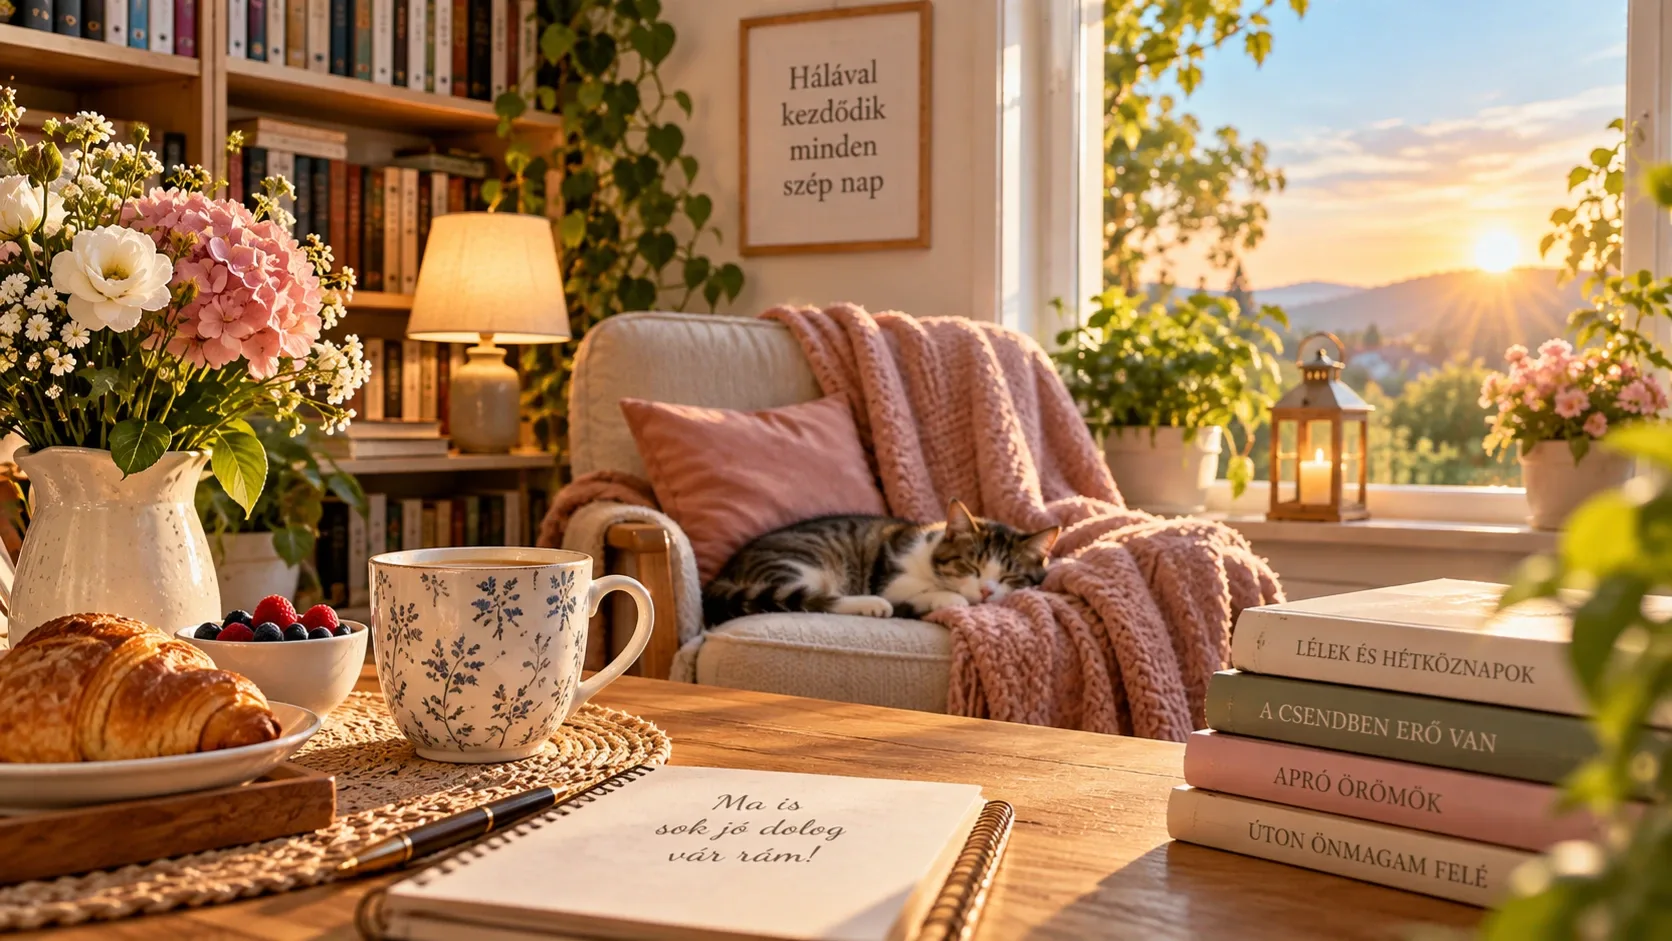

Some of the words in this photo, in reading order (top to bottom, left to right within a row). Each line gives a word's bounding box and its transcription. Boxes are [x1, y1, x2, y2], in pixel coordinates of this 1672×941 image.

[789, 59, 878, 90] Hálával
[781, 95, 887, 126] kezdődik
[789, 133, 878, 161] minden
[783, 172, 833, 202] szép
[841, 174, 884, 199] nap
[1296, 639, 1351, 662] LÉLEK
[1356, 643, 1377, 665] ÉS
[1382, 649, 1535, 684] HÉTKÖZNAPOK
[1259, 702, 1273, 720] A
[1278, 704, 1389, 736] CSENDBEN
[1397, 720, 1442, 744] ERŐ
[1449, 728, 1497, 753] VAN
[712, 794, 766, 811] Ma
[777, 798, 802, 811] is
[1273, 766, 1331, 792] APRÓ
[1338, 773, 1443, 814] ÖRÖMÖK
[655, 818, 710, 835] sok
[709, 821, 749, 841] jó
[759, 819, 846, 841] dolog
[668, 847, 726, 862] vár
[737, 845, 821, 862] rám!
[1248, 820, 1305, 849] ÚTON
[1311, 832, 1427, 876] ÖNMAGAM
[1434, 860, 1489, 889] FELÉ
